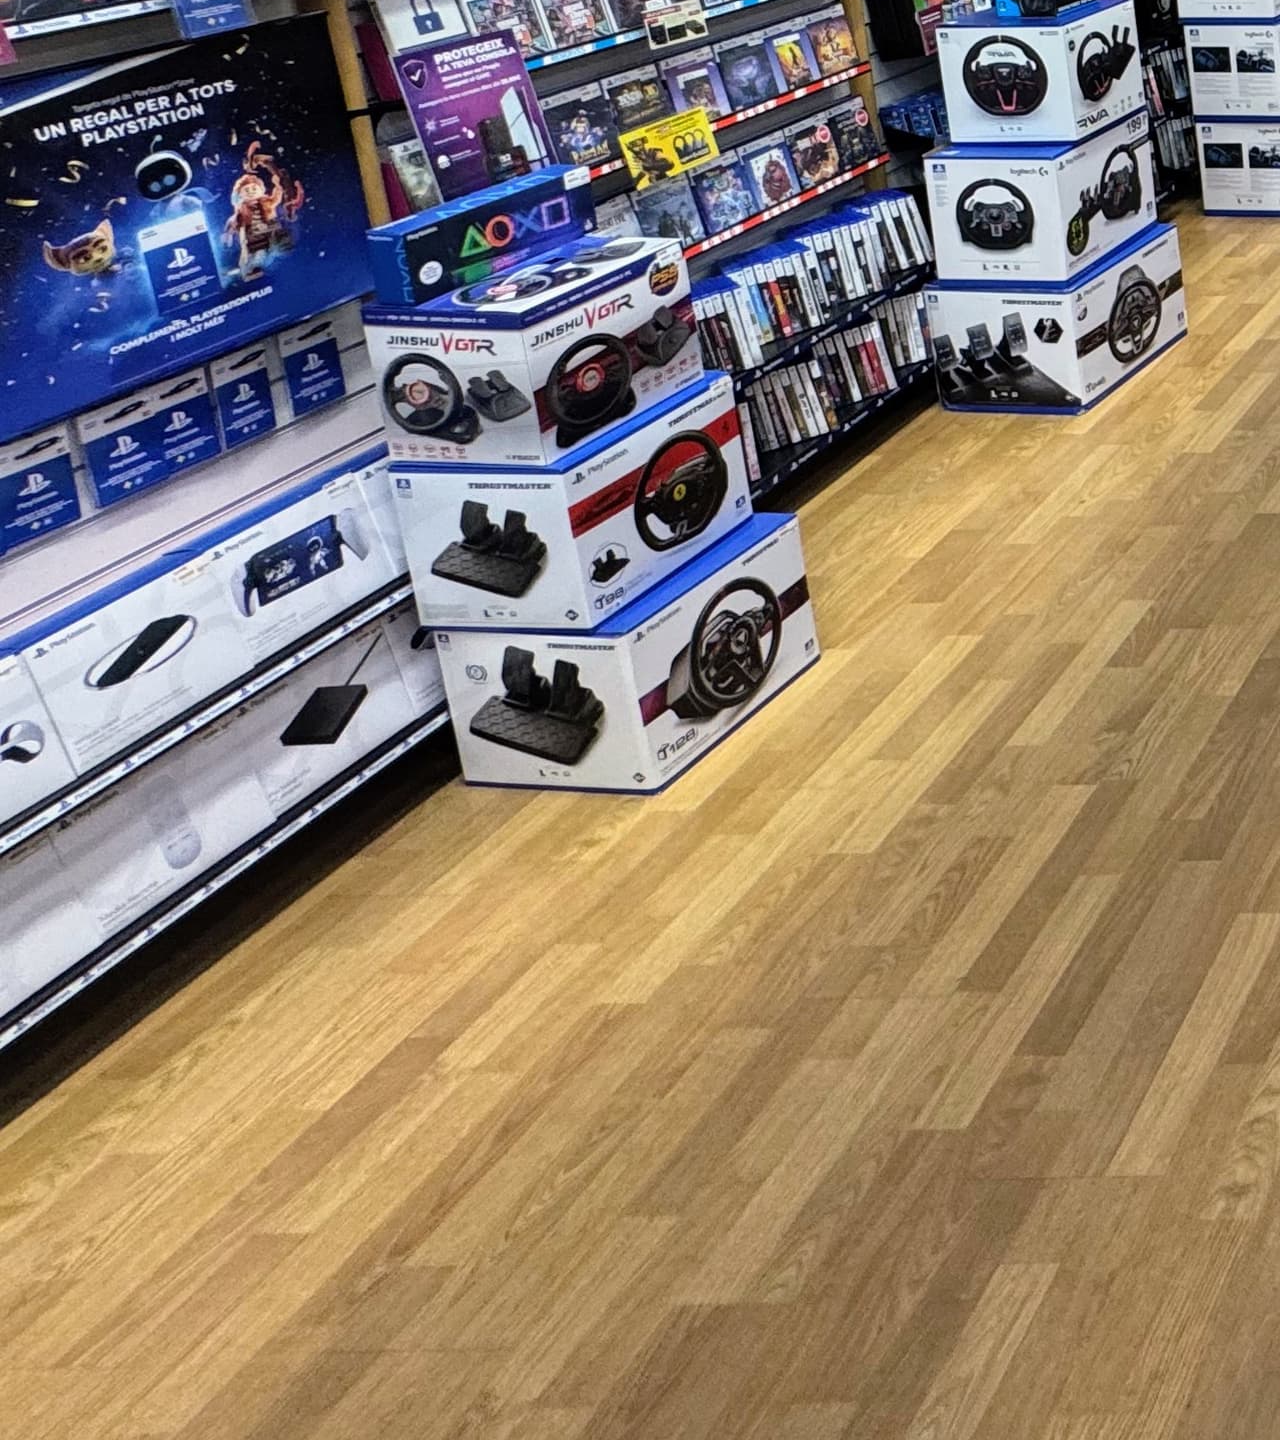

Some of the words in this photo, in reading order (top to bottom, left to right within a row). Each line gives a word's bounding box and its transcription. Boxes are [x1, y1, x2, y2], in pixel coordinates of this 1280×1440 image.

[433, 38, 505, 65] PROTEGEIX
[437, 65, 451, 73] LA
[452, 58, 475, 70] TEVA
[475, 46, 516, 62] CONSOLA
[33, 124, 67, 143] UN
[69, 108, 130, 134] REGAL
[134, 96, 171, 116] PER
[174, 91, 187, 106] A
[189, 79, 236, 103] TOTS
[81, 103, 205, 148] PLAYSTATION
[387, 336, 439, 346] JINSHU
[531, 314, 584, 348] JINSHU
[586, 448, 629, 477] PlayStation
[467, 482, 552, 491] THRUSTMASTER
[546, 643, 617, 651] THRUSTMASTER
